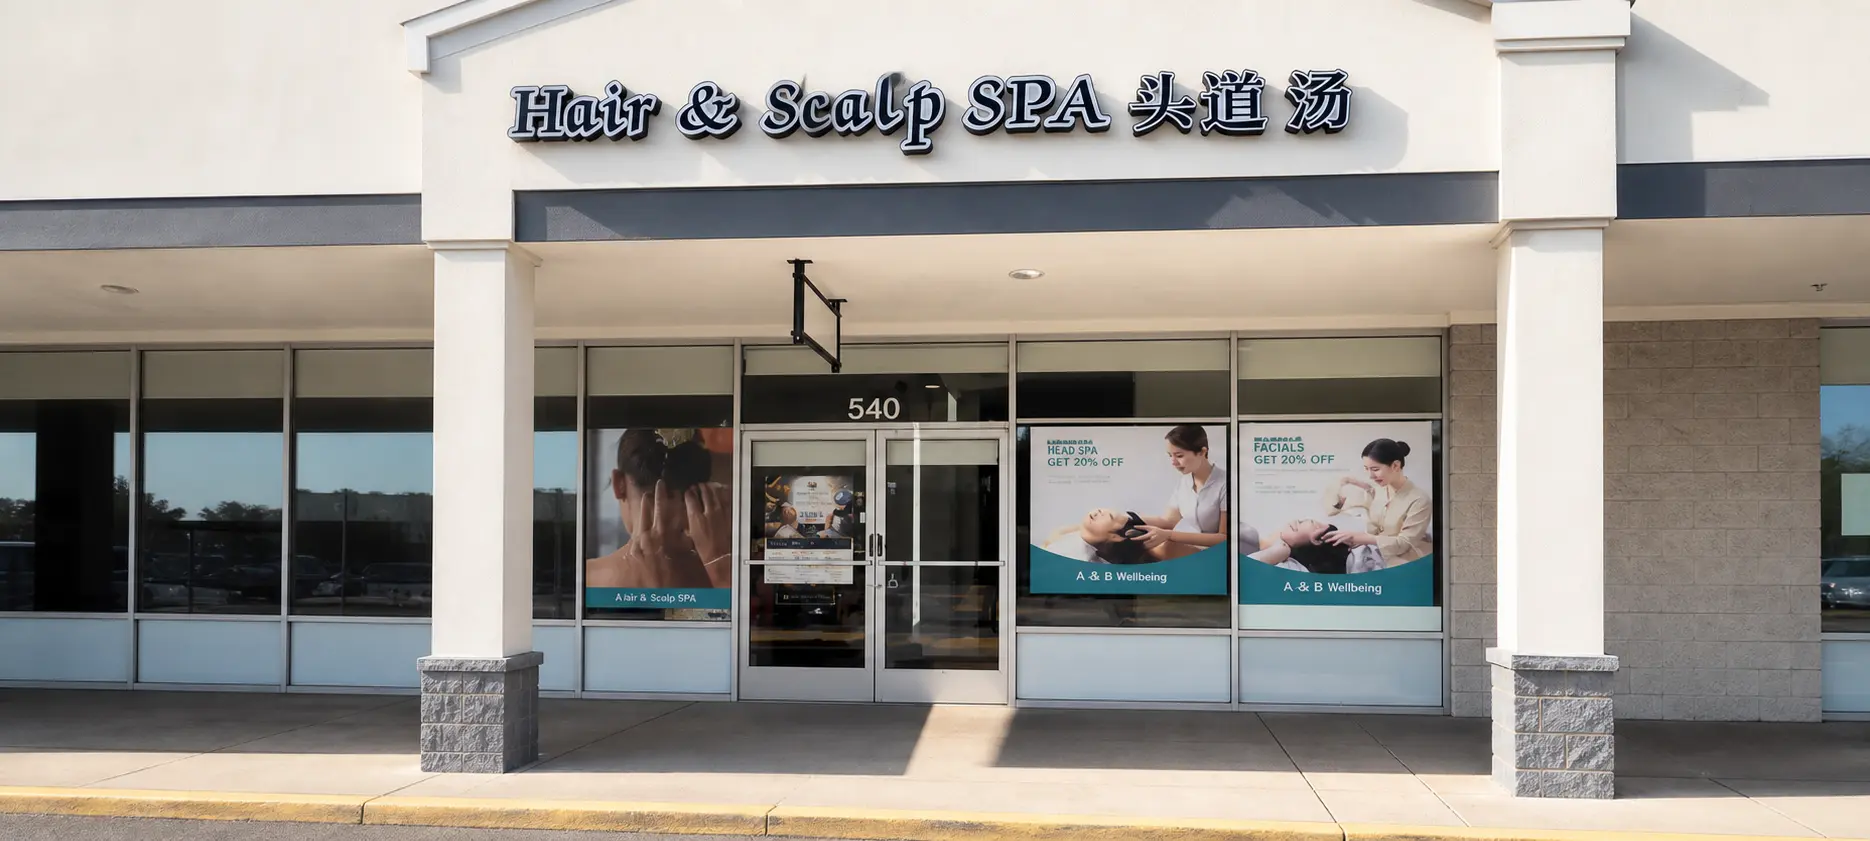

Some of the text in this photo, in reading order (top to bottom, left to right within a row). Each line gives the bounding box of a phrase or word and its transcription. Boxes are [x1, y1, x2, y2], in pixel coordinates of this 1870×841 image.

[507, 72, 1112, 156] Hair & Scalp SPA
[847, 397, 901, 420] 540
[1047, 445, 1098, 455] HEAD SPA
[1253, 442, 1305, 453] FACIALS
[1047, 457, 1124, 467] GET 20% OFF
[1254, 454, 1335, 464] GET 20% OFF
[1076, 571, 1168, 584] A & B Wellbeing
[1283, 582, 1293, 592] A
[1314, 582, 1323, 592] B
[1328, 582, 1382, 595] Wellbeing
[677, 593, 697, 603] SPA
